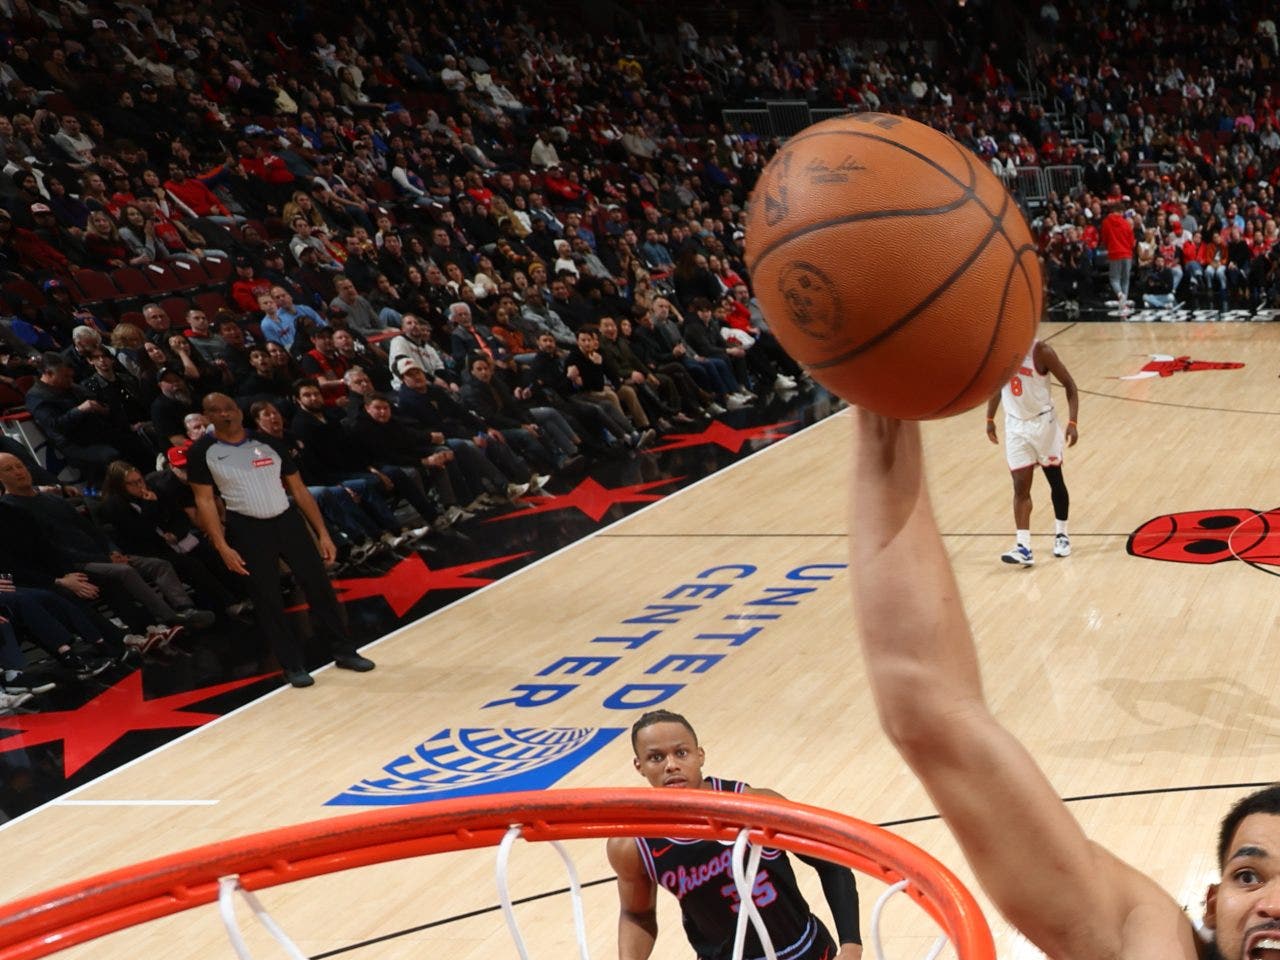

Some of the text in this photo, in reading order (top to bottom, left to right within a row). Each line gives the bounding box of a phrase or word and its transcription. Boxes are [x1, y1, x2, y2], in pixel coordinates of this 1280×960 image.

[479, 563, 758, 710] CENTER
[602, 563, 849, 710] UNITED
[660, 848, 735, 901] Chicag
